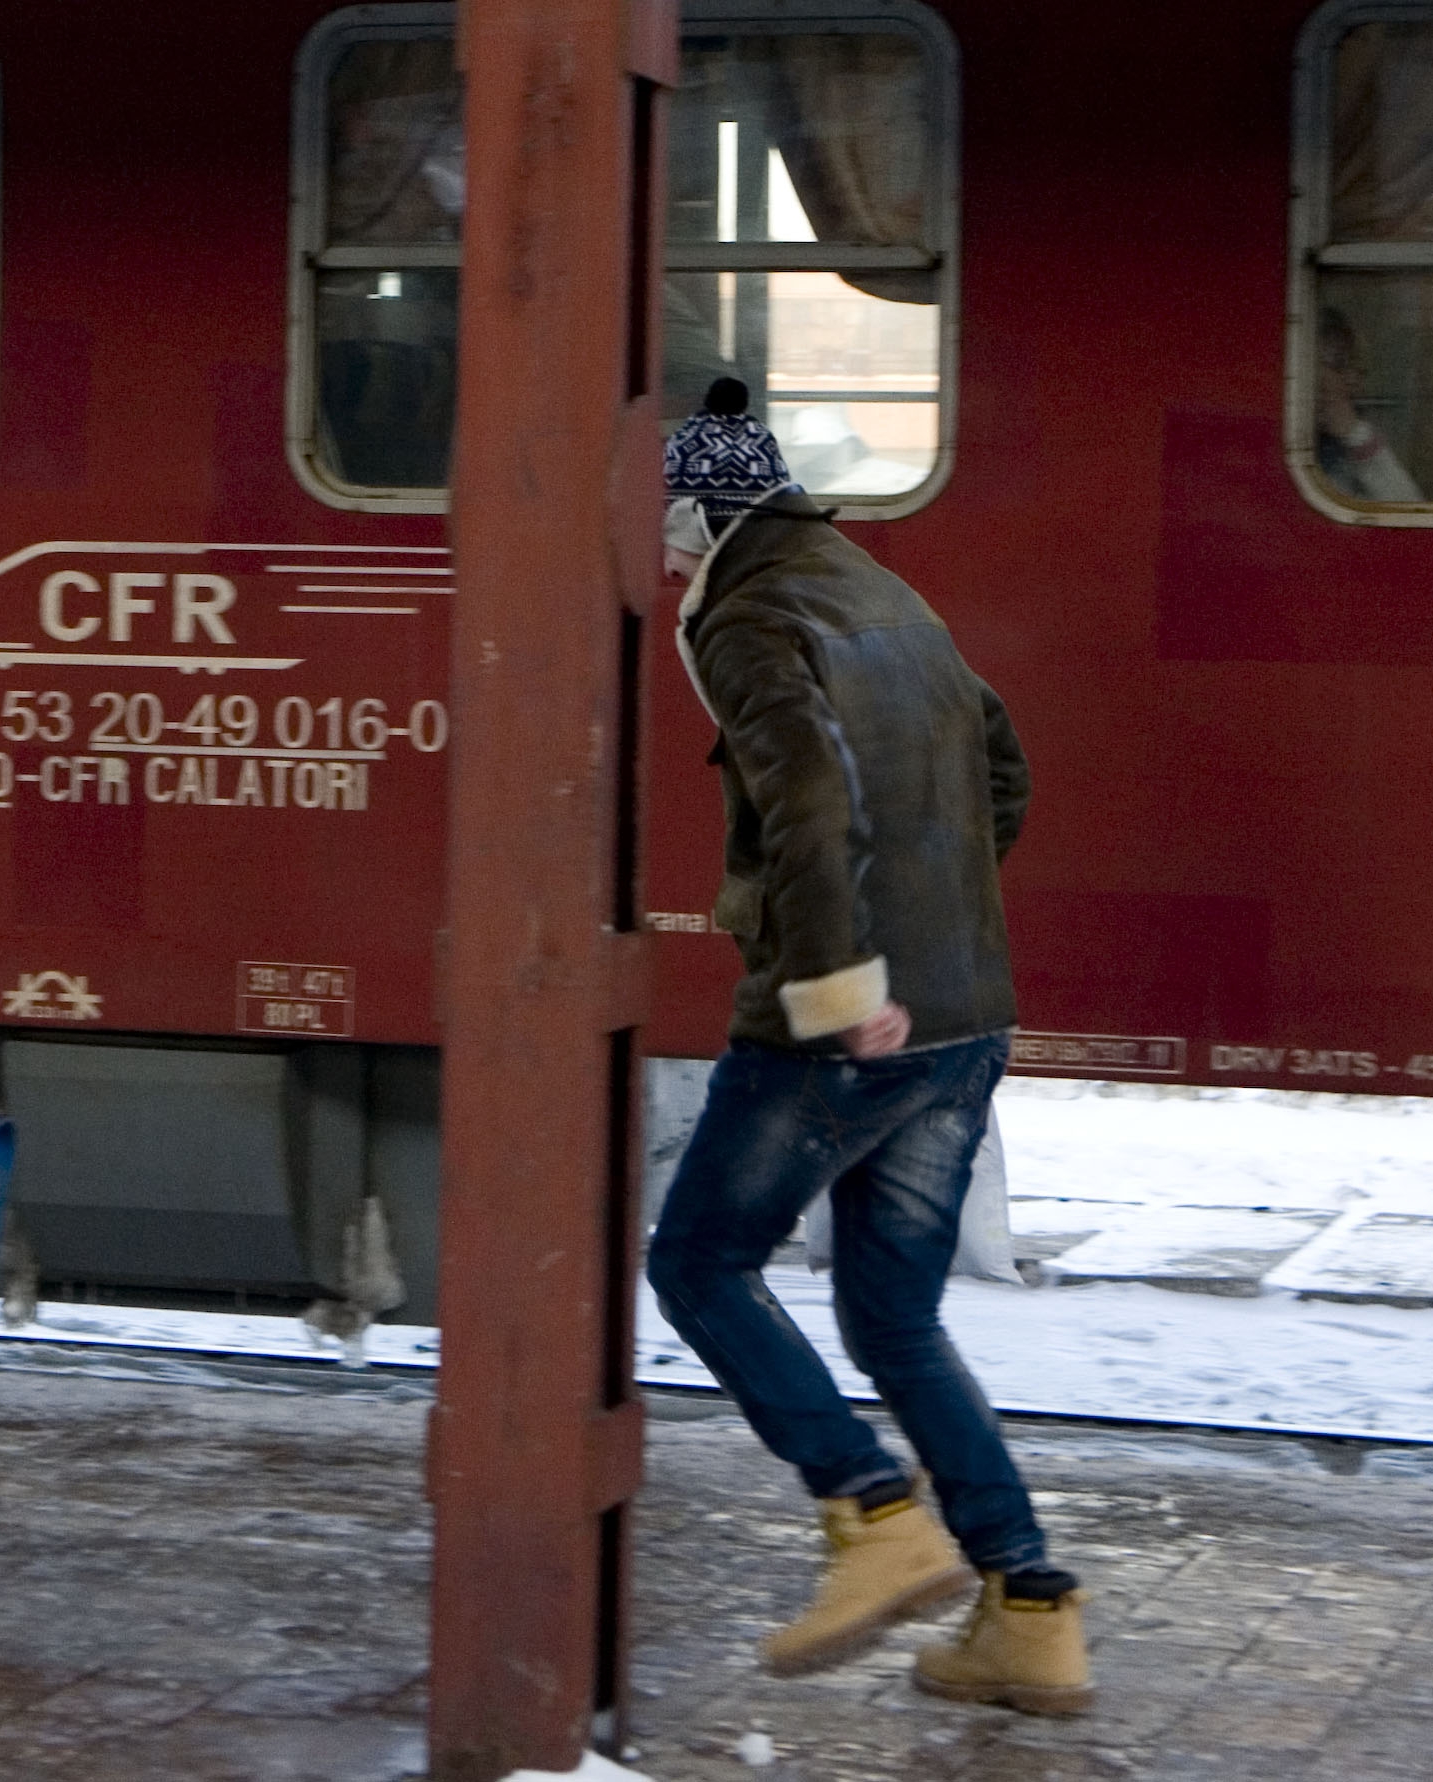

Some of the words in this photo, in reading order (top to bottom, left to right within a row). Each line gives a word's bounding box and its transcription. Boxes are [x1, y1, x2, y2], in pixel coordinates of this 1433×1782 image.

[39, 570, 238, 645] CFR
[0, 690, 74, 742] 53
[89, 692, 258, 746] 20-49
[273, 697, 448, 752] 016-0
[145, 757, 367, 811] CALATORI
[1210, 1045, 1285, 1073] DRV
